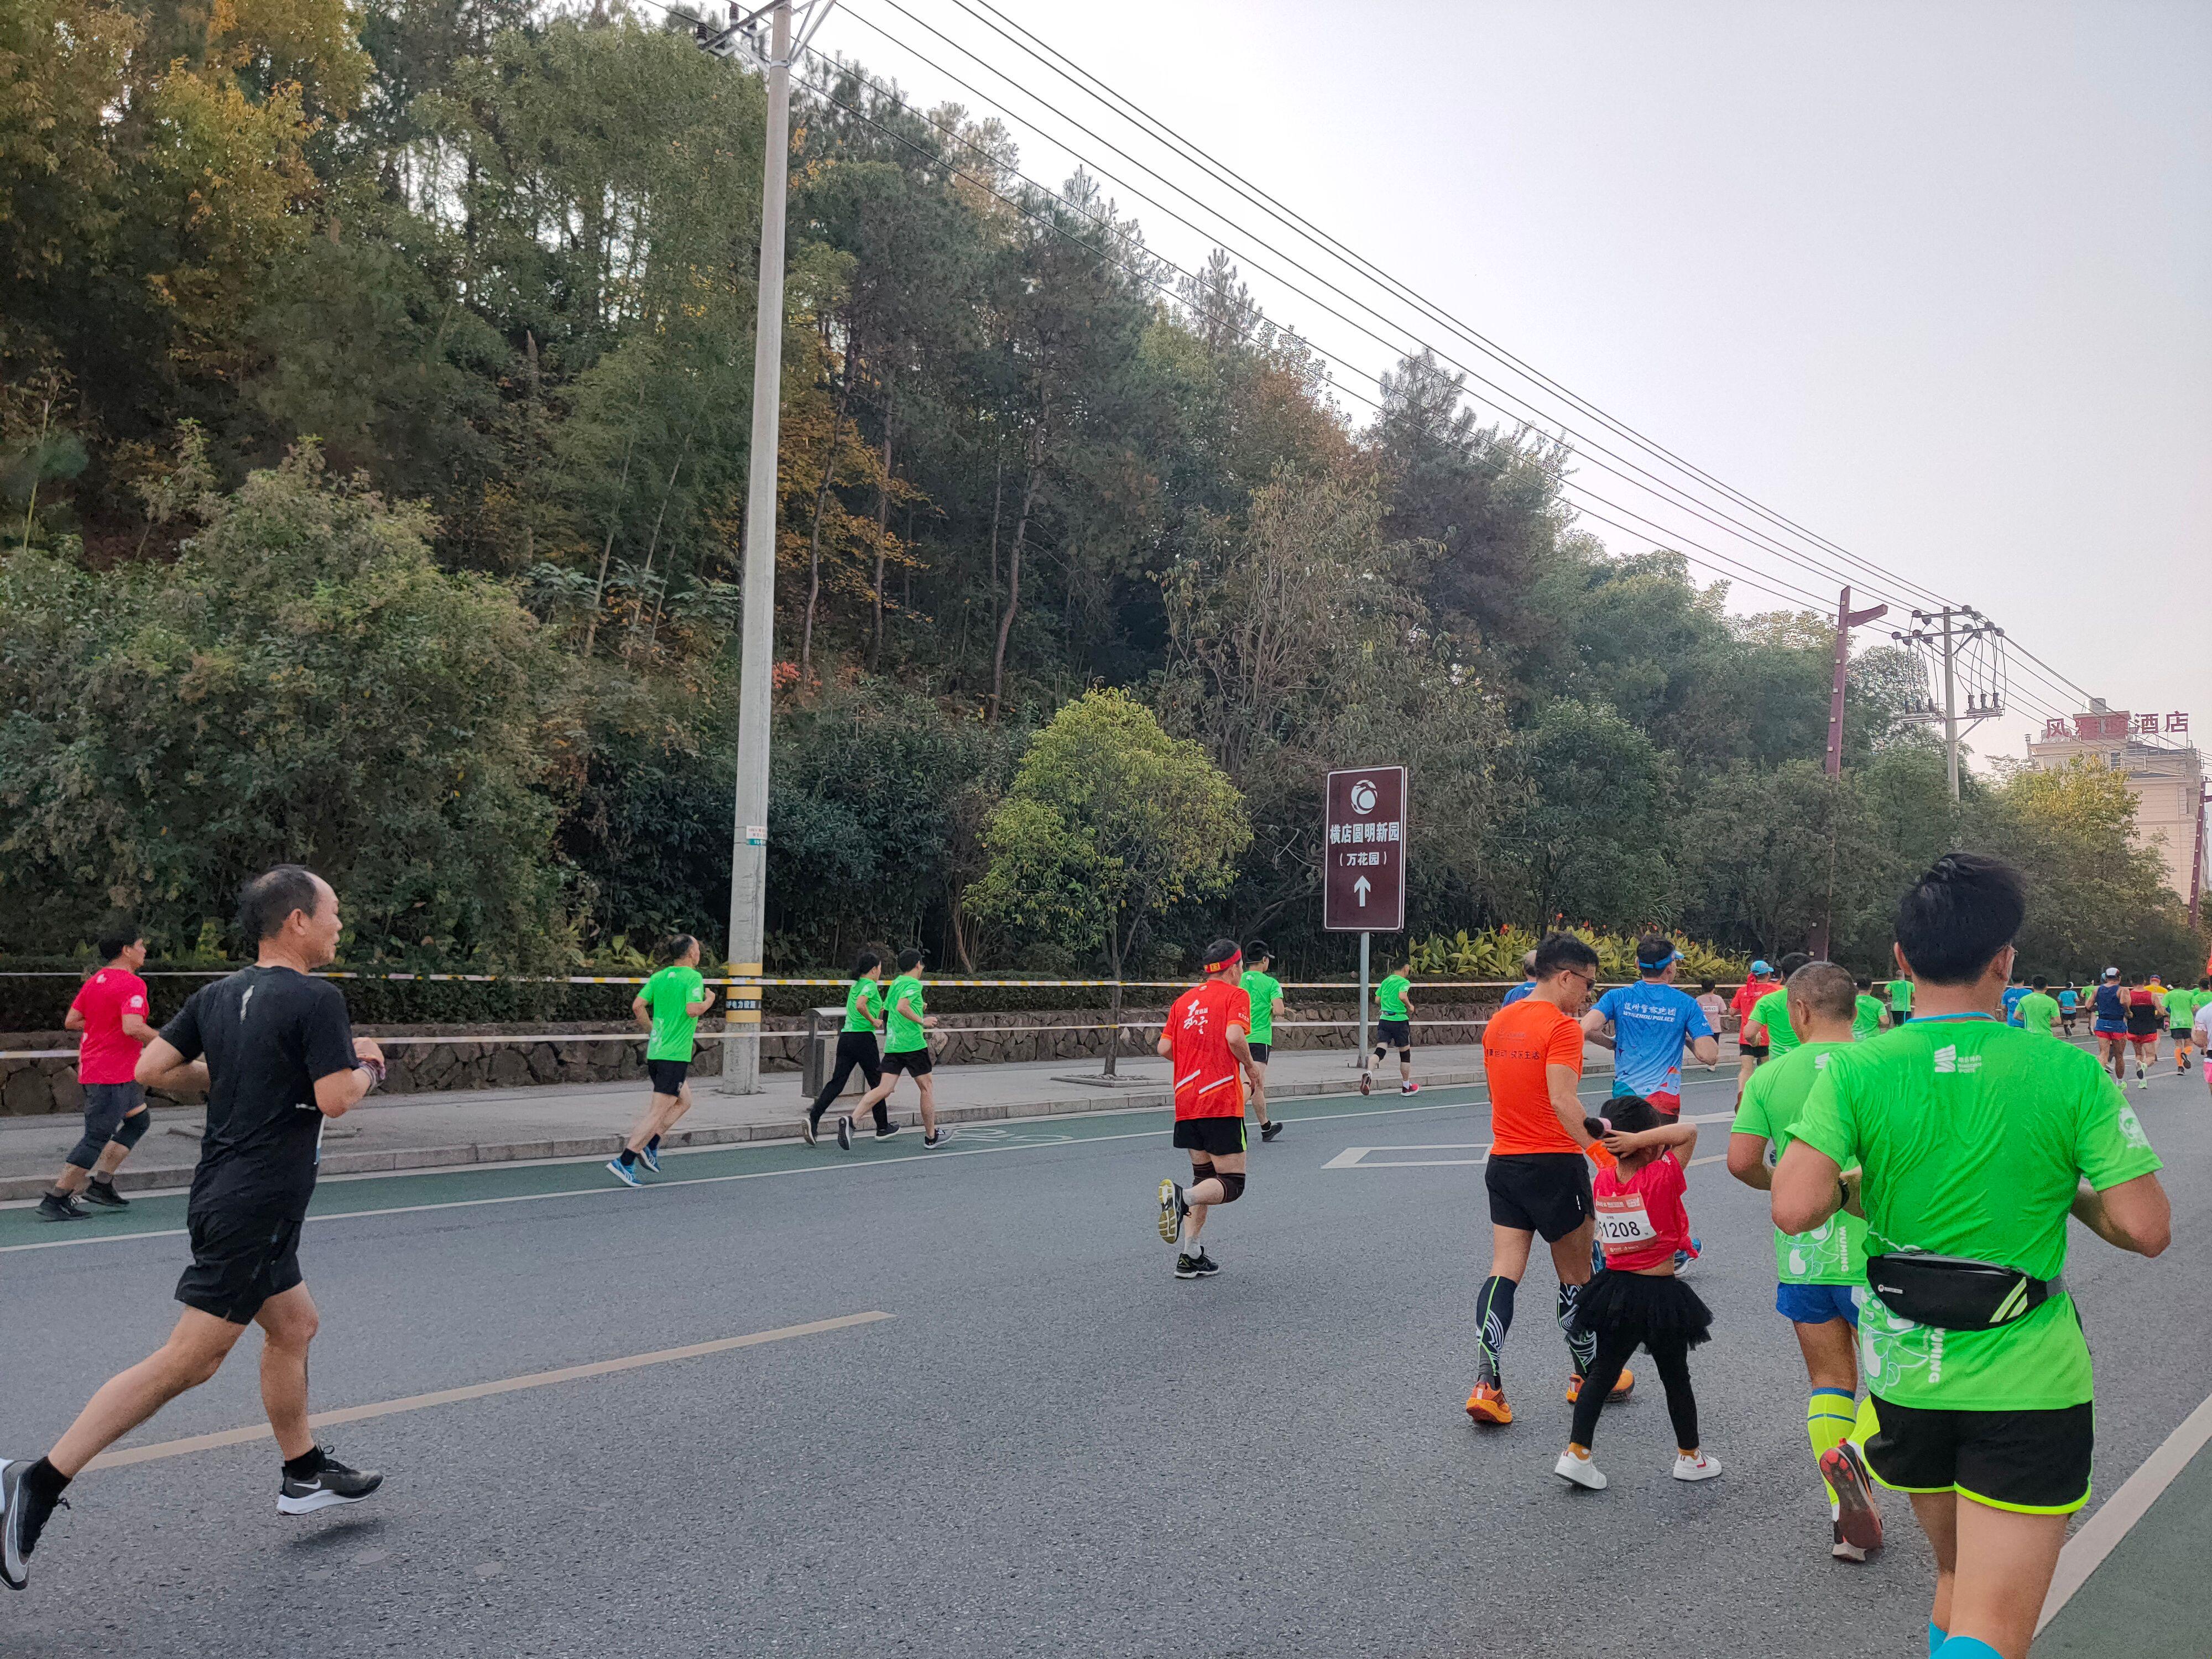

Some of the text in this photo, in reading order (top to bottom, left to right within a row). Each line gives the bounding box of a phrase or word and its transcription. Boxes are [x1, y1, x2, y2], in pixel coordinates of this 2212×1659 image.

[1330, 822, 1400, 844] 横店圆明新园
[1839, 1226, 1849, 1272] WUMING
